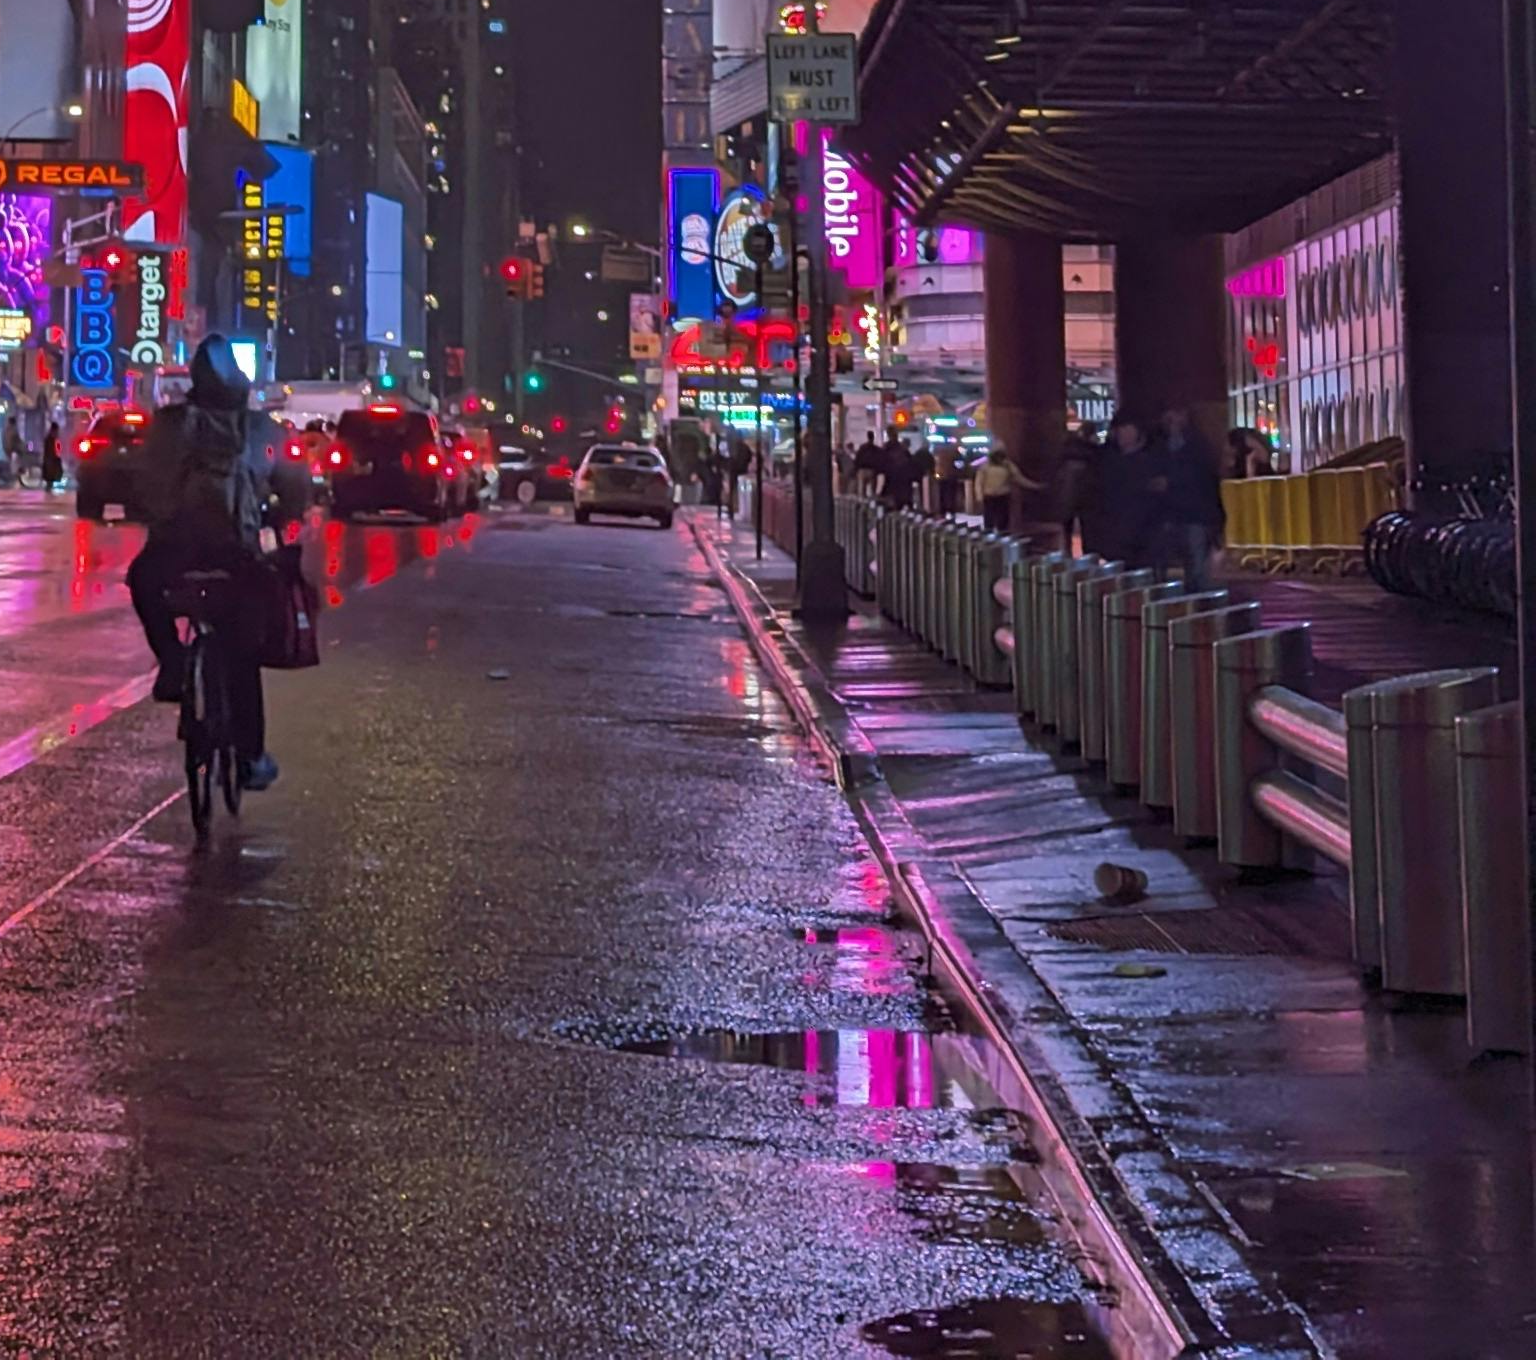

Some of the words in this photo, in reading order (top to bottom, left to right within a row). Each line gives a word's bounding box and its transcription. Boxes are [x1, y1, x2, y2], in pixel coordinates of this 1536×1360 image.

[774, 44, 807, 60] LEFT
[813, 44, 849, 60] LANE
[789, 69, 835, 87] MUST
[775, 96, 812, 112] TN
[818, 96, 850, 112] LEFT
[16, 164, 132, 185] REGAL
[137, 255, 166, 340] target
